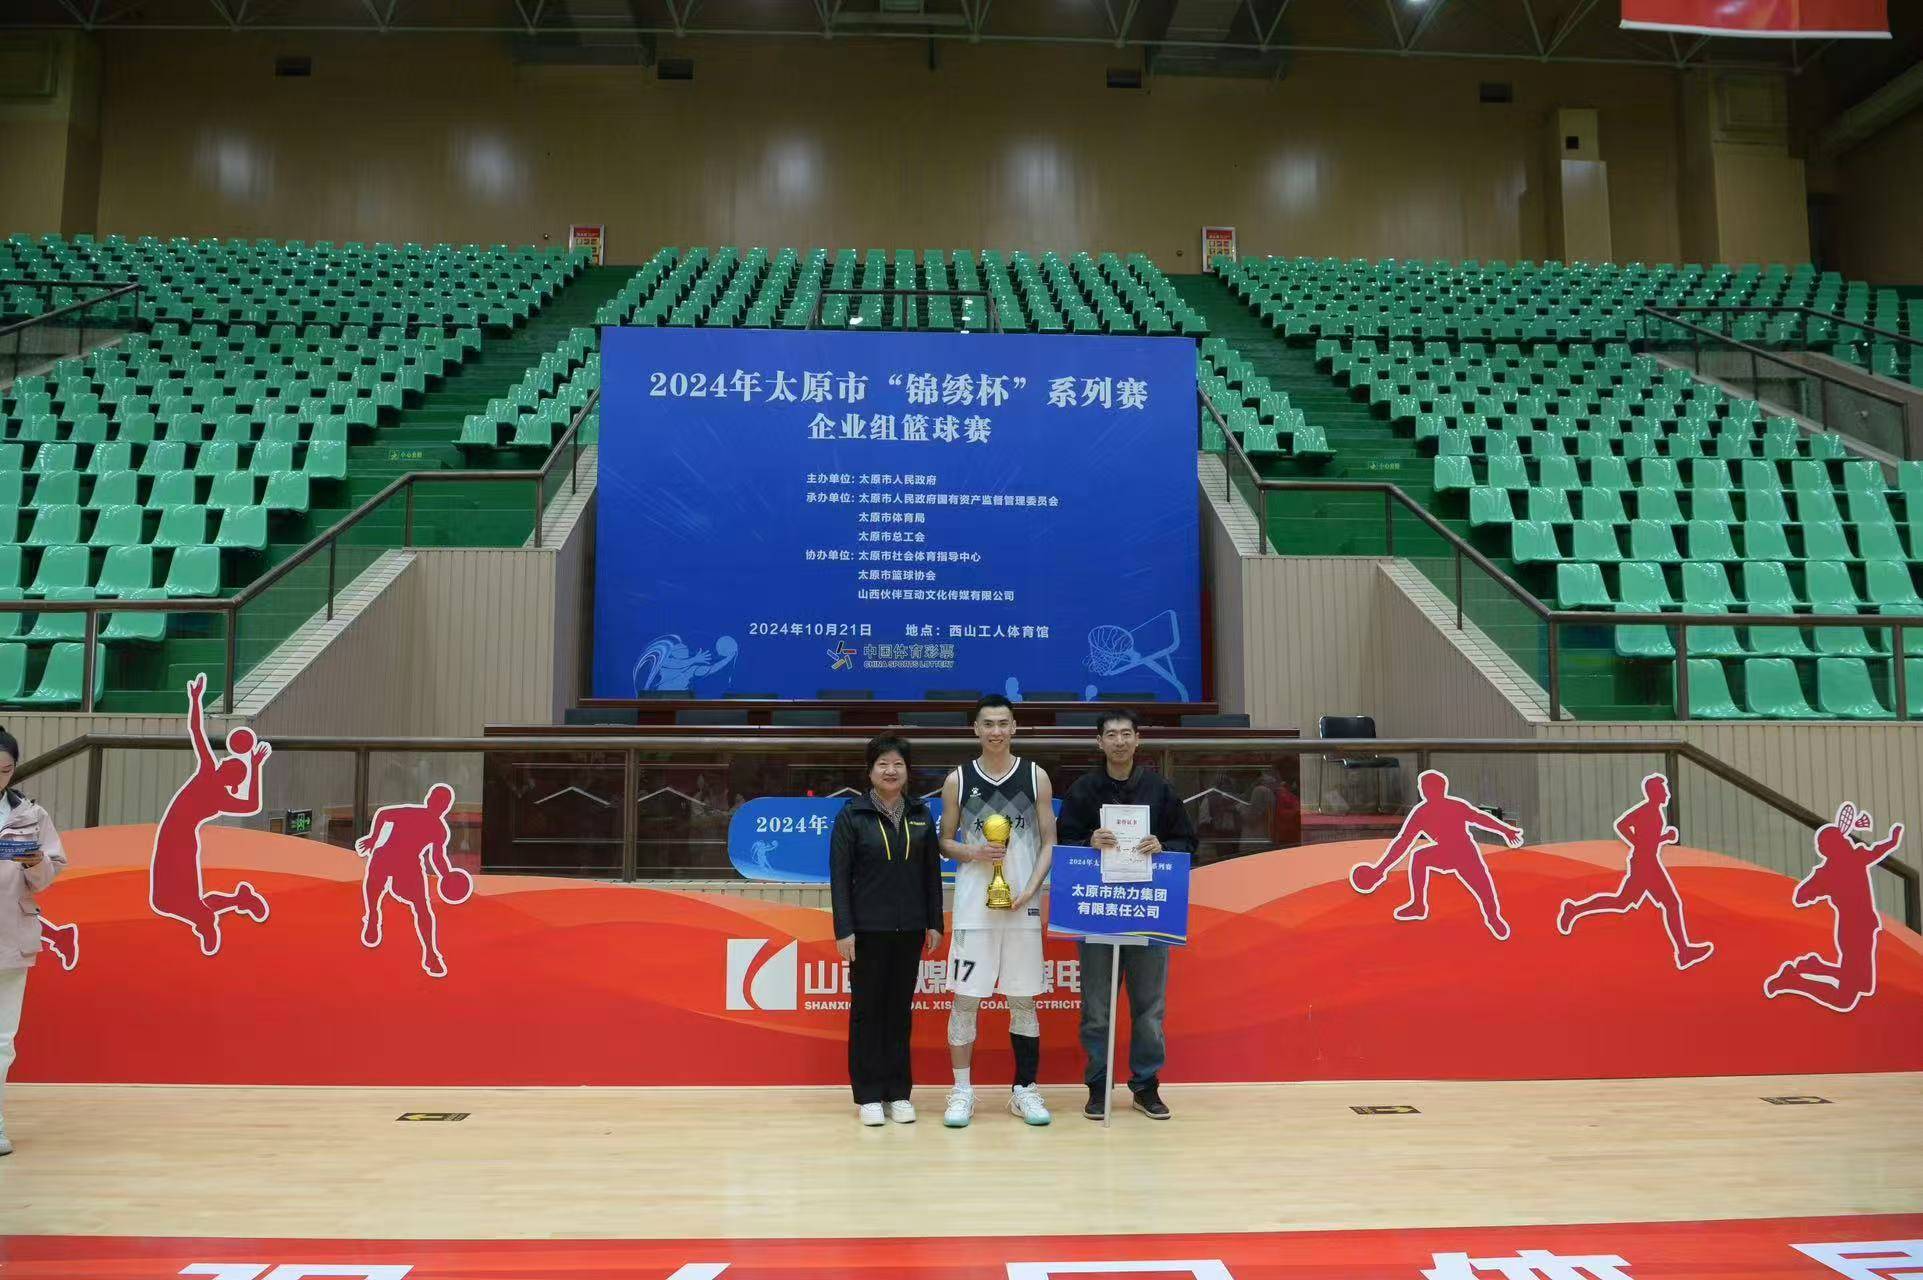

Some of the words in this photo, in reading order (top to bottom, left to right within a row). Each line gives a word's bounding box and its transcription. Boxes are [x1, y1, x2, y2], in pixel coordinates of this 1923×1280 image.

[807, 412, 992, 444] 企业组篮球赛
[858, 512, 925, 524] 太原市体育局
[858, 531, 925, 543] 太原市总工会
[858, 570, 936, 582] 太原市篮球协会
[858, 589, 1015, 602] 山西伙伴互动文化传媒有限公司
[749, 623, 872, 637] 2024年10月21日
[863, 643, 955, 660] 中国体育彩票
[756, 814, 834, 836] 2024年
[1071, 884, 1168, 902] 太原市热力集团
[1077, 901, 1160, 919] 有限责任公司
[804, 960, 851, 995] 山
[953, 959, 977, 982] 17
[804, 1001, 849, 1010] SHANXI
